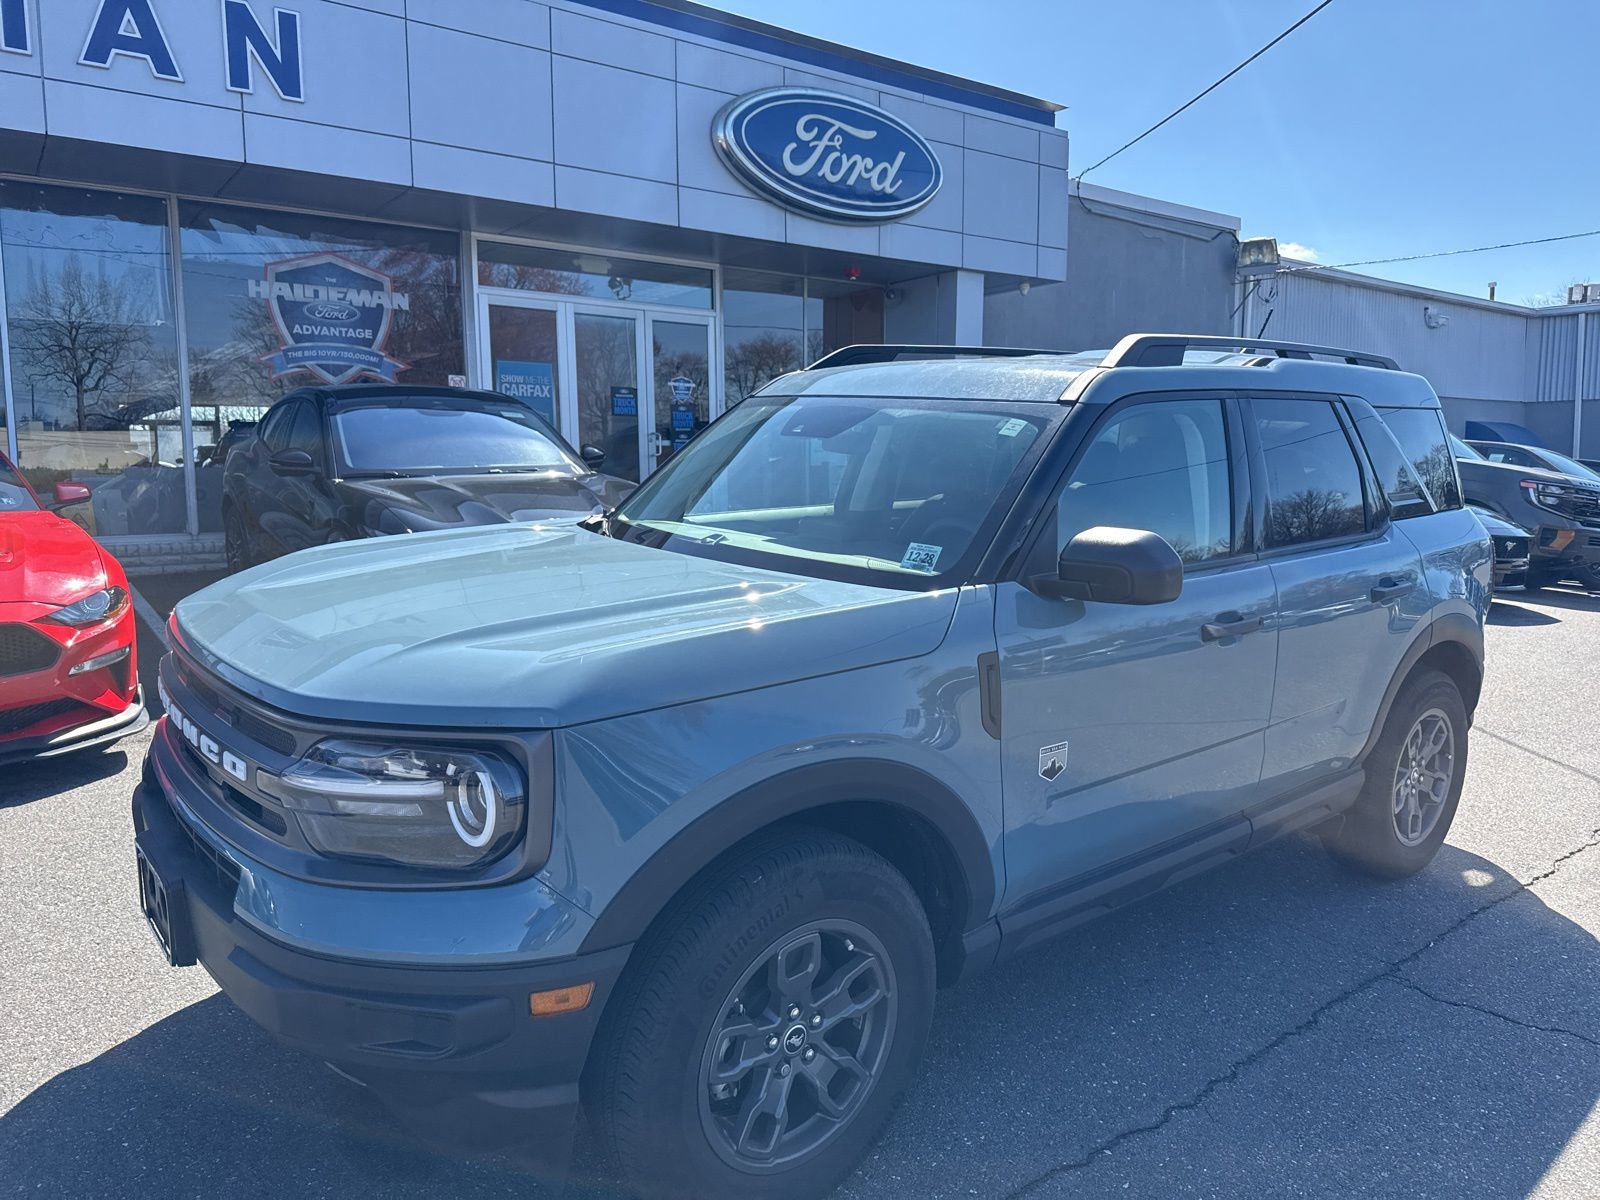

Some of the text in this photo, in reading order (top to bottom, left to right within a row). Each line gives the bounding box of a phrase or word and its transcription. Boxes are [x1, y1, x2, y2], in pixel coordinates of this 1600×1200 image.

[782, 113, 906, 194] Ford
[248, 279, 409, 311] HALDEMAN
[314, 304, 350, 321] Ford
[292, 324, 373, 339] ADVANTAGE
[287, 351, 303, 359] THE
[500, 374, 524, 383] SHOW
[501, 383, 551, 398] CARFAX
